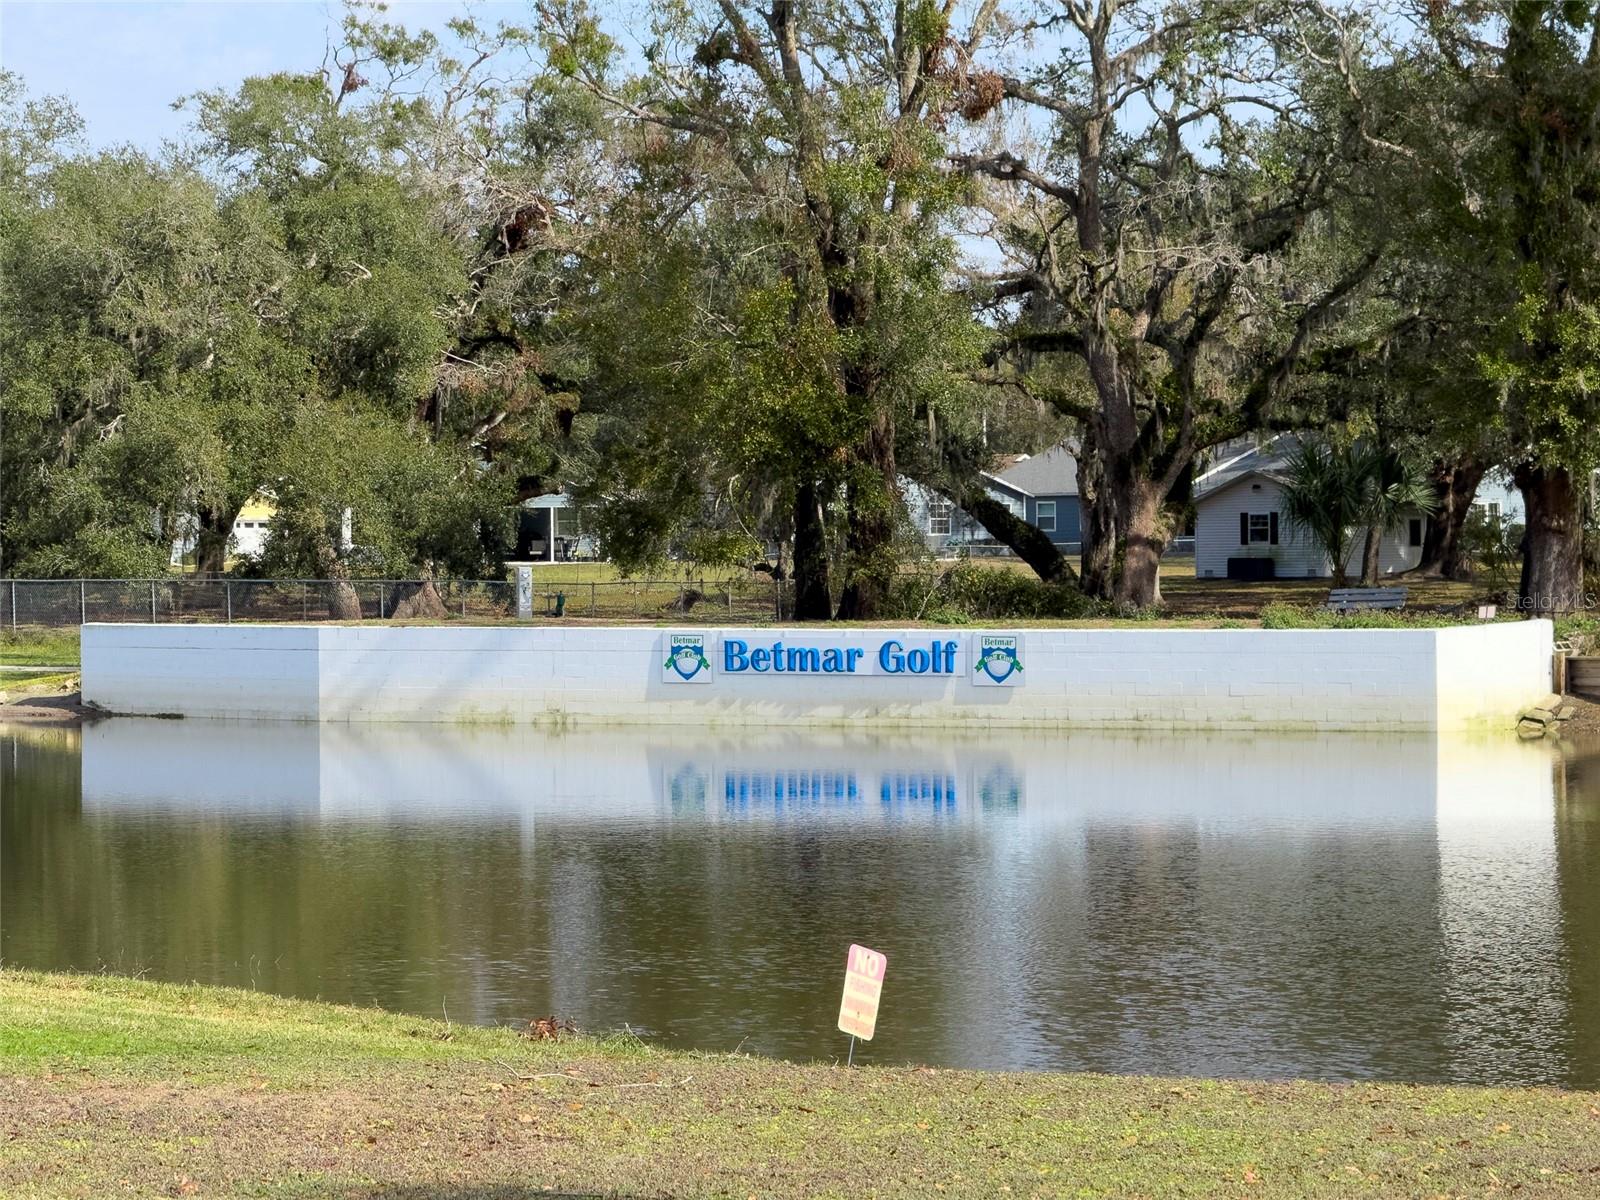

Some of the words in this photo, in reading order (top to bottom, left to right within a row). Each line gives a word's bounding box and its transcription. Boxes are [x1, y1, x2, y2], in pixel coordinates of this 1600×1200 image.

[673, 636, 701, 644] Betmar
[984, 638, 1013, 646] Betmar
[724, 640, 863, 673] Betmar
[879, 640, 959, 673] Golf
[854, 948, 880, 977] NO
